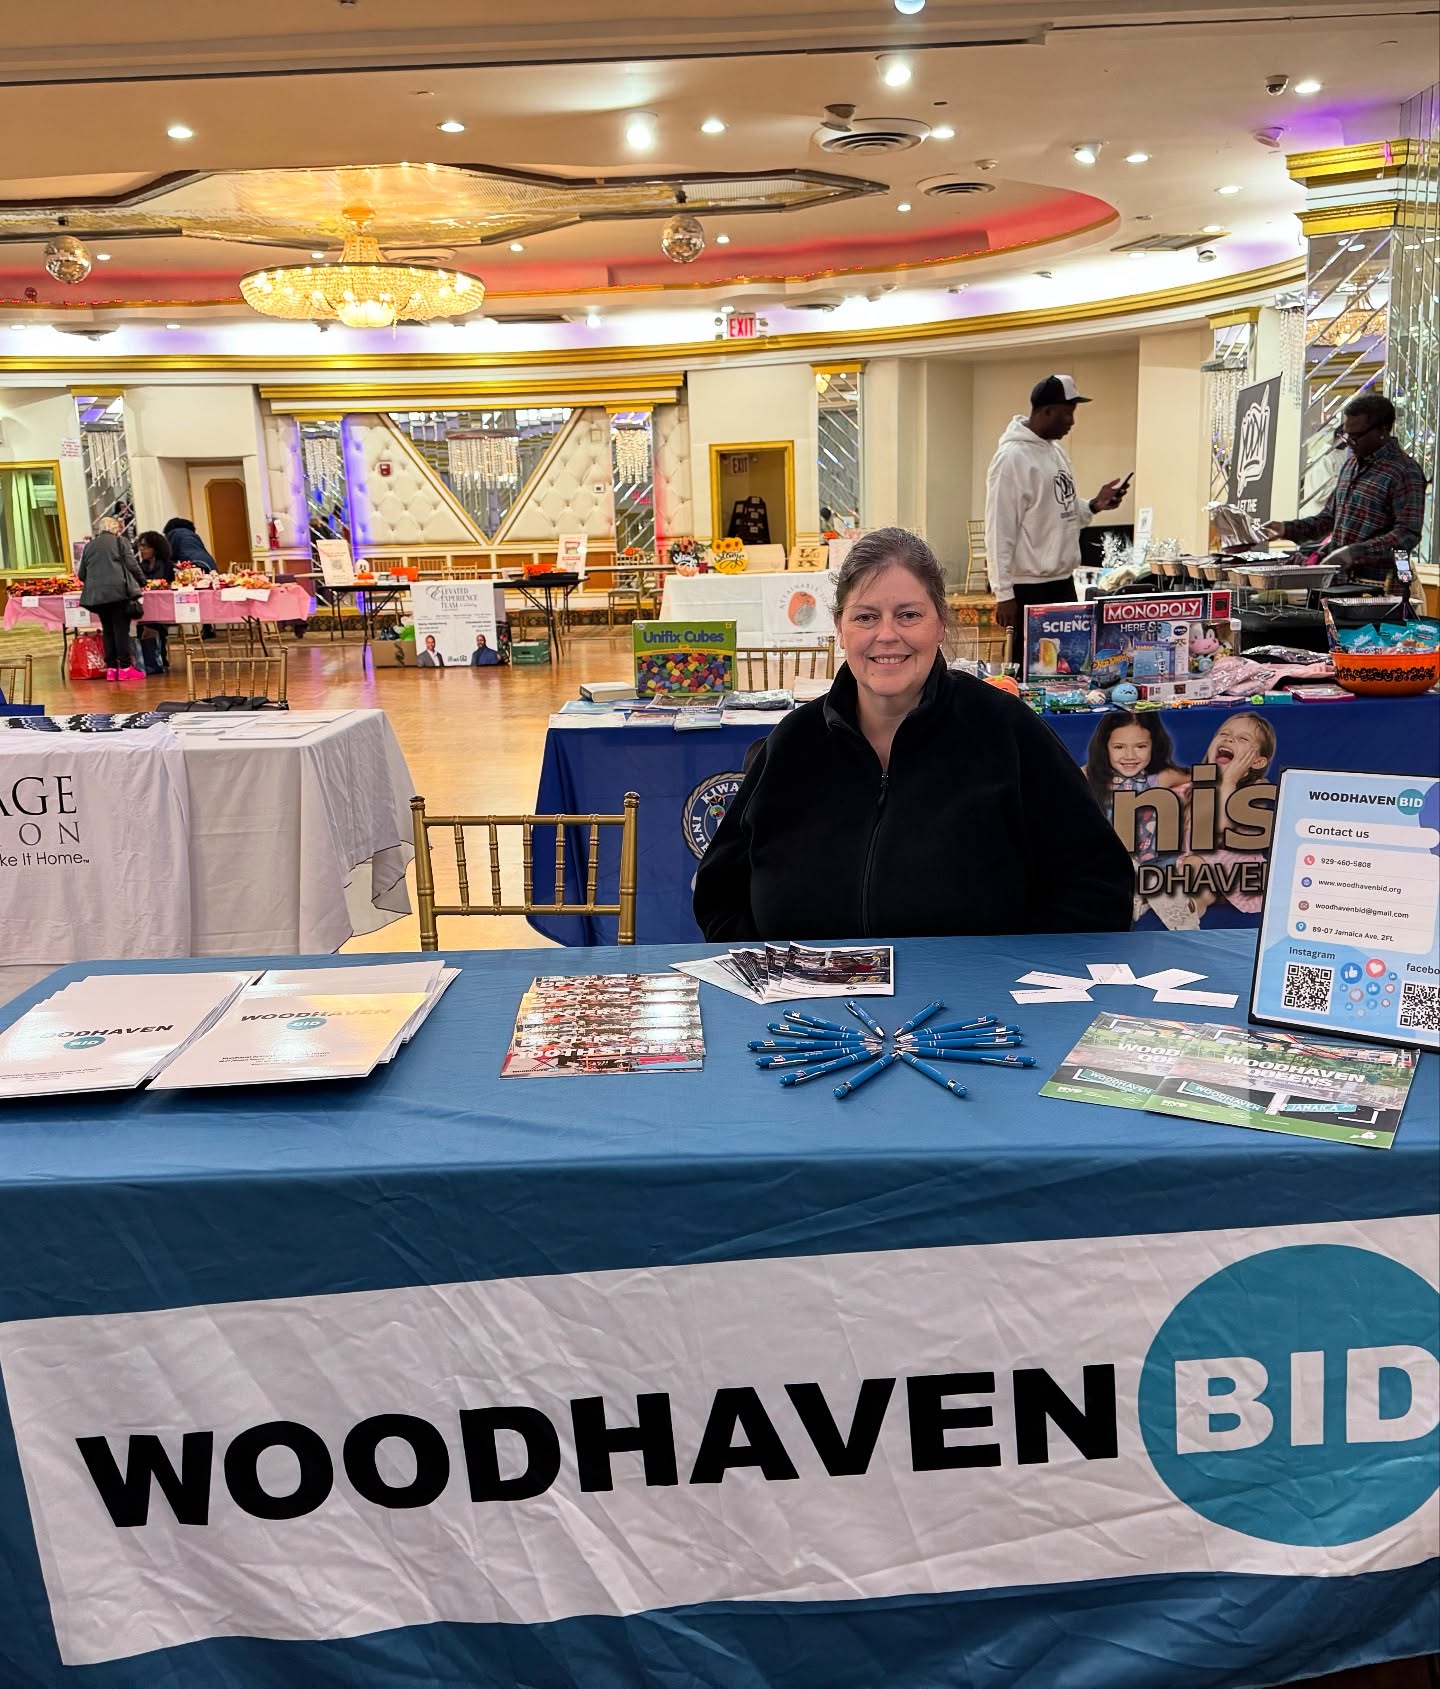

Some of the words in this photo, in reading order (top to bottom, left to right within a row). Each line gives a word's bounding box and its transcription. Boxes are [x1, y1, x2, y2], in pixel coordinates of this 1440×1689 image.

[729, 317, 755, 338] EXIT
[732, 456, 748, 473] EXIT
[1107, 601, 1200, 621] MONOPOLY
[1042, 620, 1091, 633] SCIENC
[1120, 622, 1146, 633] HERE
[643, 629, 681, 644] Unifix
[684, 629, 724, 644] Cubes
[700, 782, 740, 804] KIWA
[1308, 790, 1396, 806] WOODHAVEN
[1400, 797, 1424, 808] BID
[1112, 763, 1278, 853] nis
[1308, 825, 1353, 838] Contact
[1355, 830, 1370, 839] us
[22, 852, 32, 866] It
[1320, 857, 1372, 869] 929-460-5808
[1318, 880, 1402, 895] www.woodhavenbid.org
[1315, 903, 1410, 919] woodhavenbid@gmail.com
[1312, 926, 1333, 935] 89-07
[1334, 929, 1363, 939] Jamaica
[1381, 934, 1395, 942] 2FL
[1289, 946, 1336, 960] Instagram
[240, 1008, 393, 1022] WOODHAVEN
[39, 1023, 175, 1039] OODHAVEN
[1118, 1042, 1182, 1057] WOOD
[1223, 1054, 1366, 1083] WOODHAVEN
[1246, 1066, 1334, 1088] QUEENS
[1194, 1084, 1264, 1112] WOODHAVEN
[1289, 1103, 1339, 1112] JAMAICA
[75, 1363, 1119, 1528] WOODHAVEN
[1174, 1344, 1440, 1454] BID
